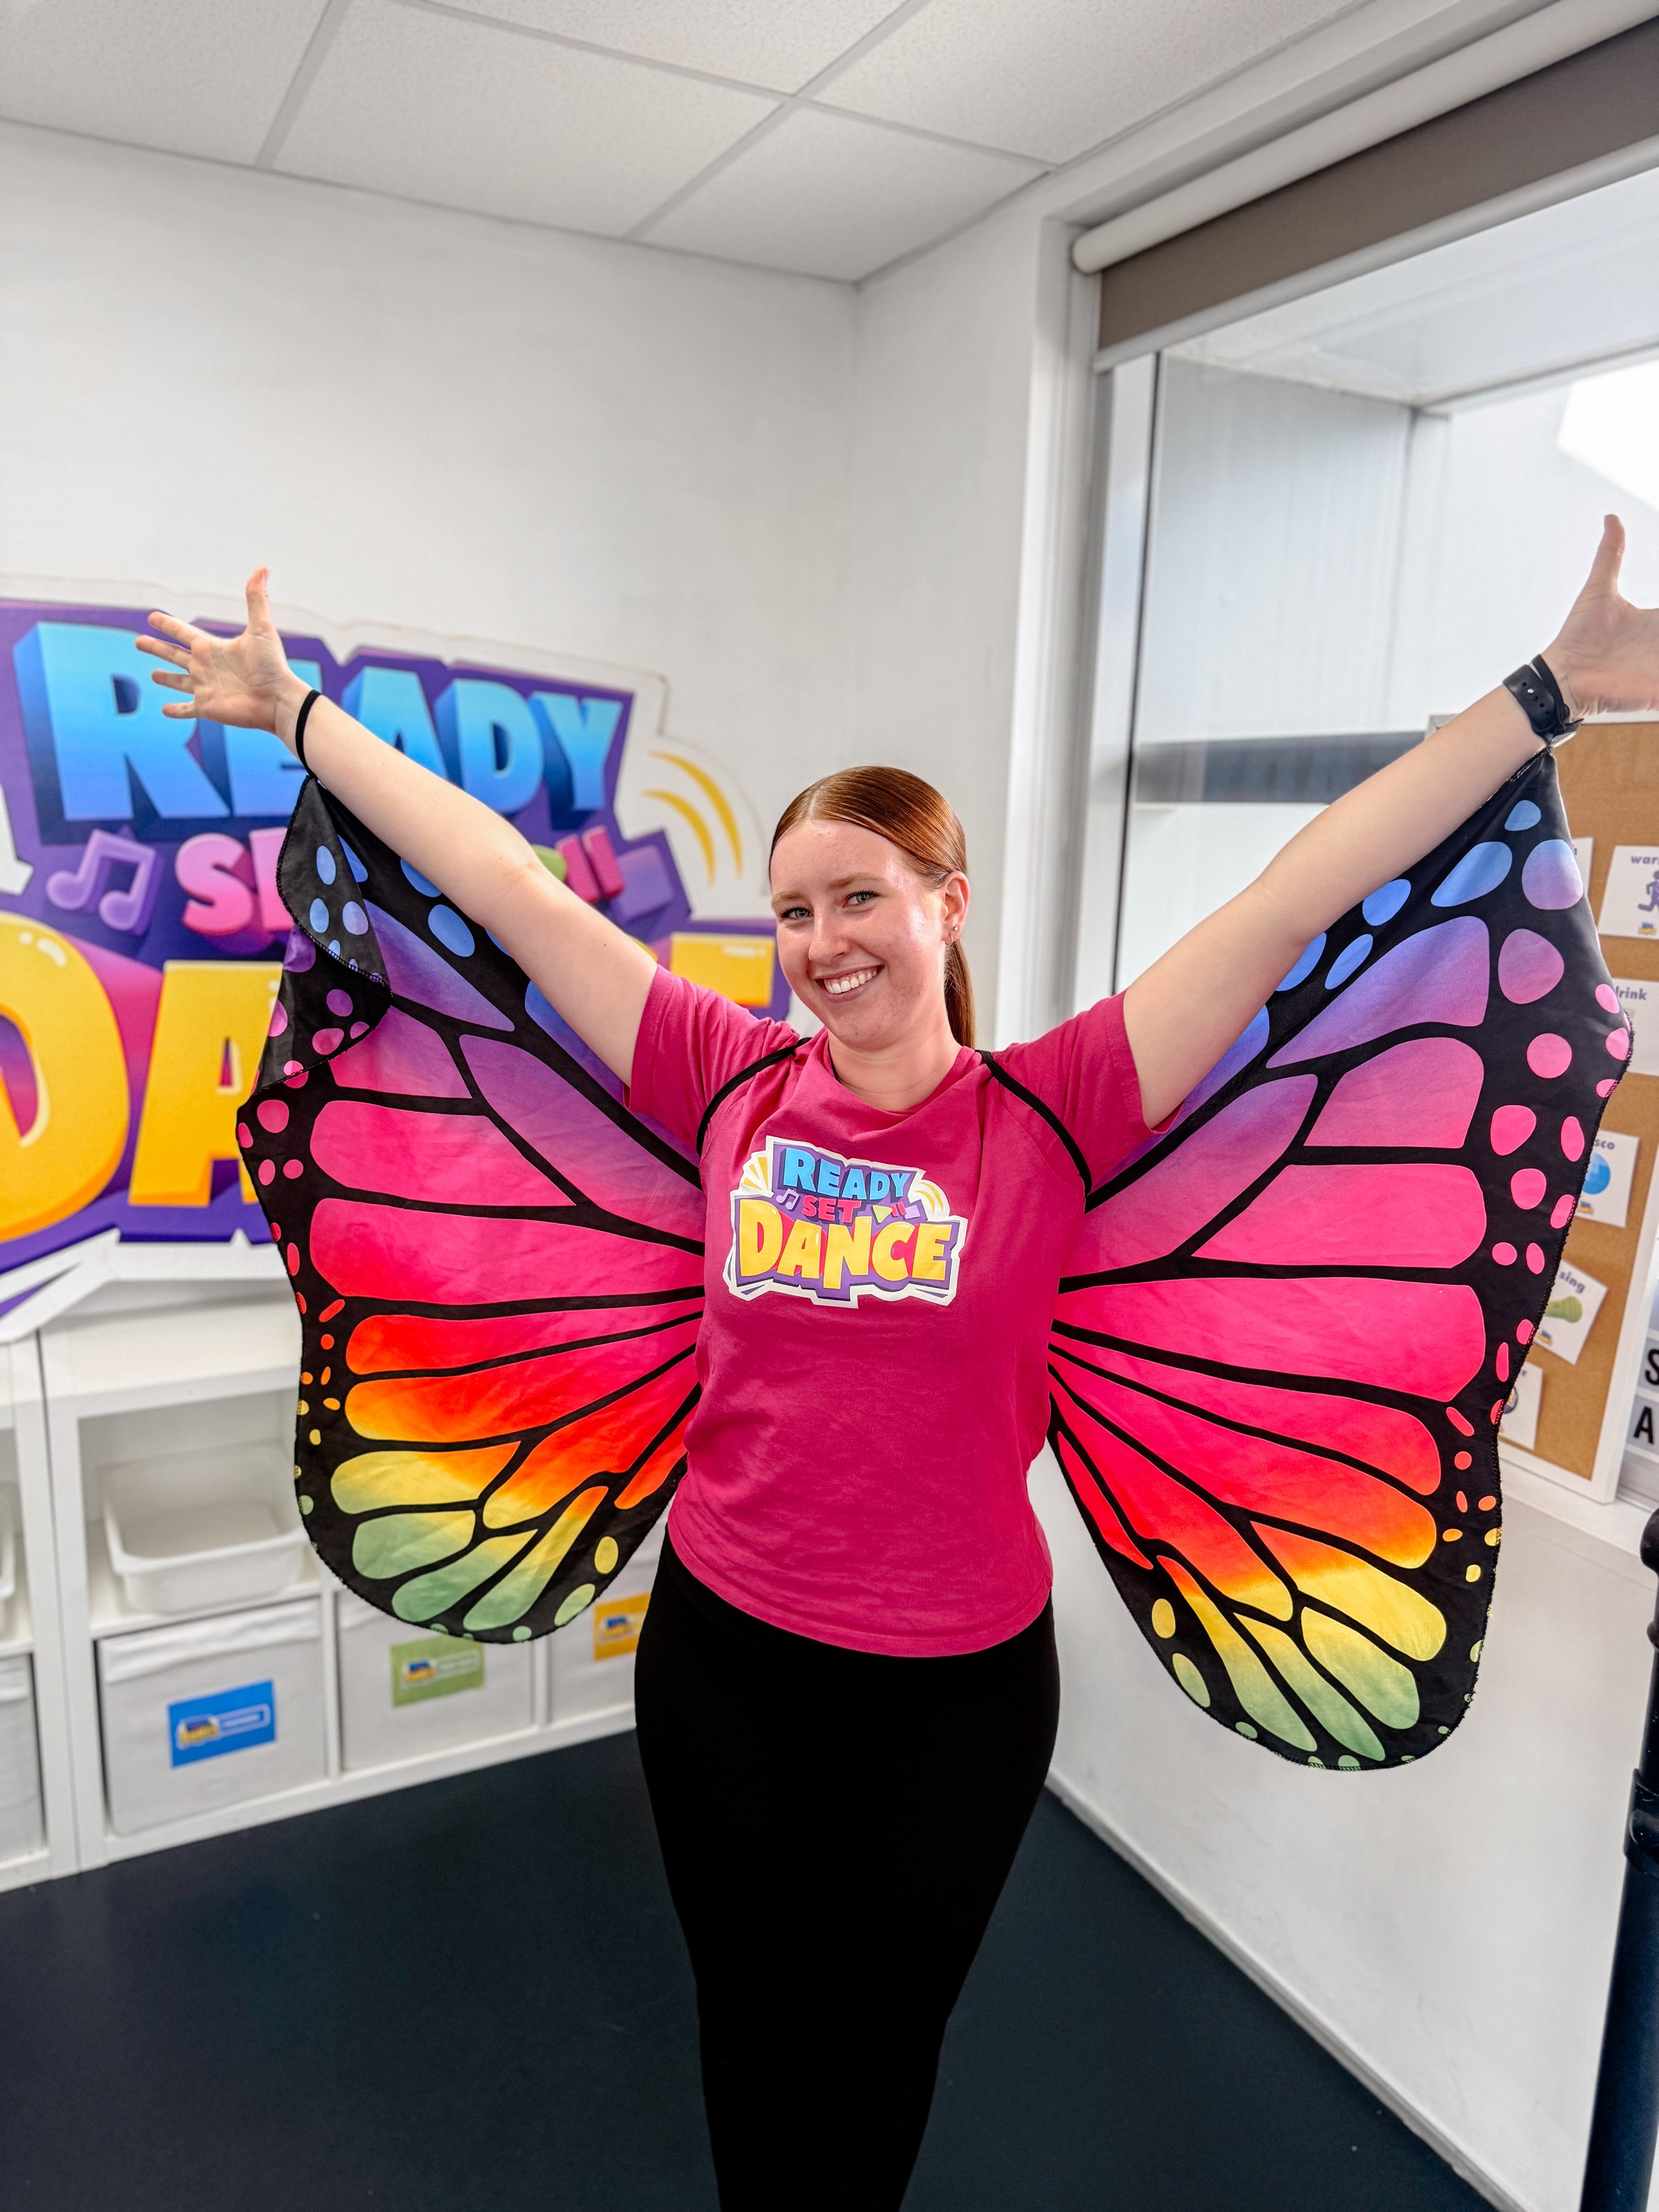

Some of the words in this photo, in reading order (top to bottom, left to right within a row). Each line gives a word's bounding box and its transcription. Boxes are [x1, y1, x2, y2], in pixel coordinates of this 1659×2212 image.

[782, 1147, 911, 1200] READY
[801, 1195, 861, 1223] SET
[739, 1199, 952, 1290] DANCE
[1559, 1271, 1585, 1293] sing
